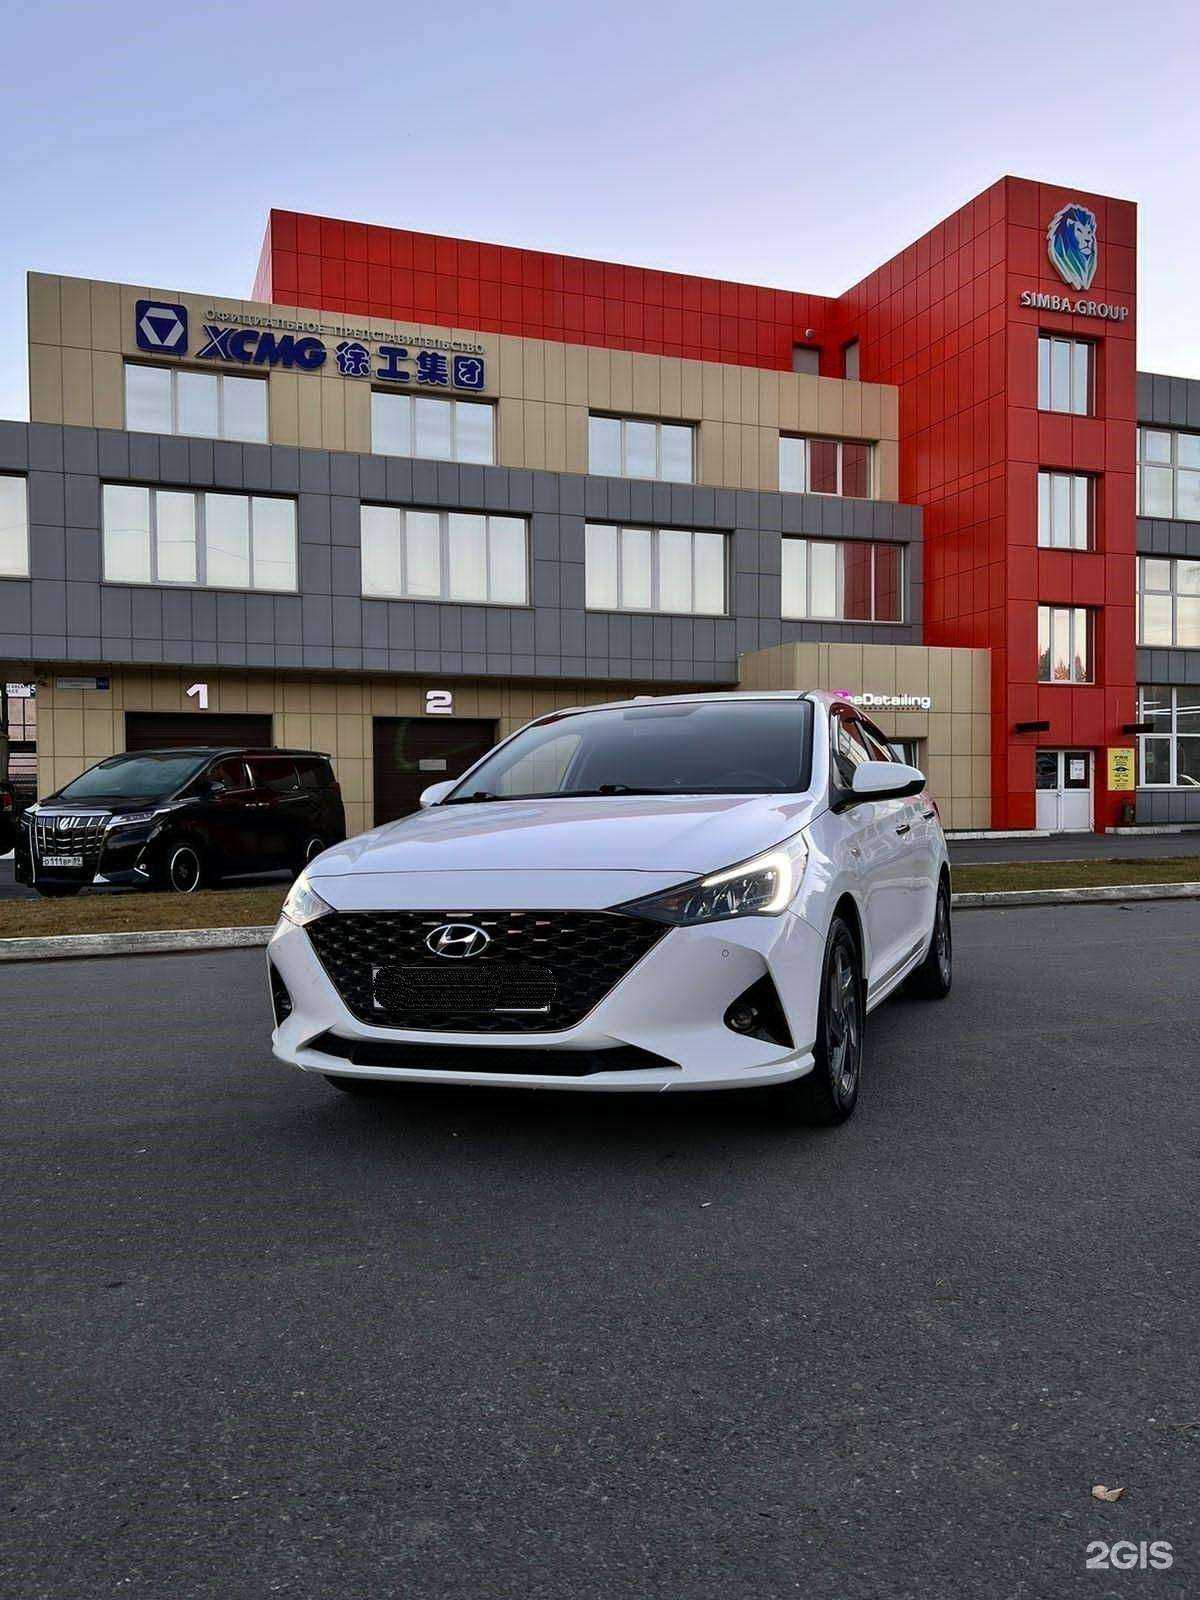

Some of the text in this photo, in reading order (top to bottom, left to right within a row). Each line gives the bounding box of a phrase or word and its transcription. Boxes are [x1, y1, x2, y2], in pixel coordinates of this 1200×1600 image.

[1020, 290, 1129, 321] SIMBA.GROUP
[195, 324, 327, 371] XCMG
[206, 310, 485, 354] ОФИЦИАЛЬНОЕ ПРЕДСТАВИТЕЛЬСТВО
[336, 341, 486, 391] 徐工集团
[186, 683, 209, 709] 1
[425, 690, 453, 714] 2
